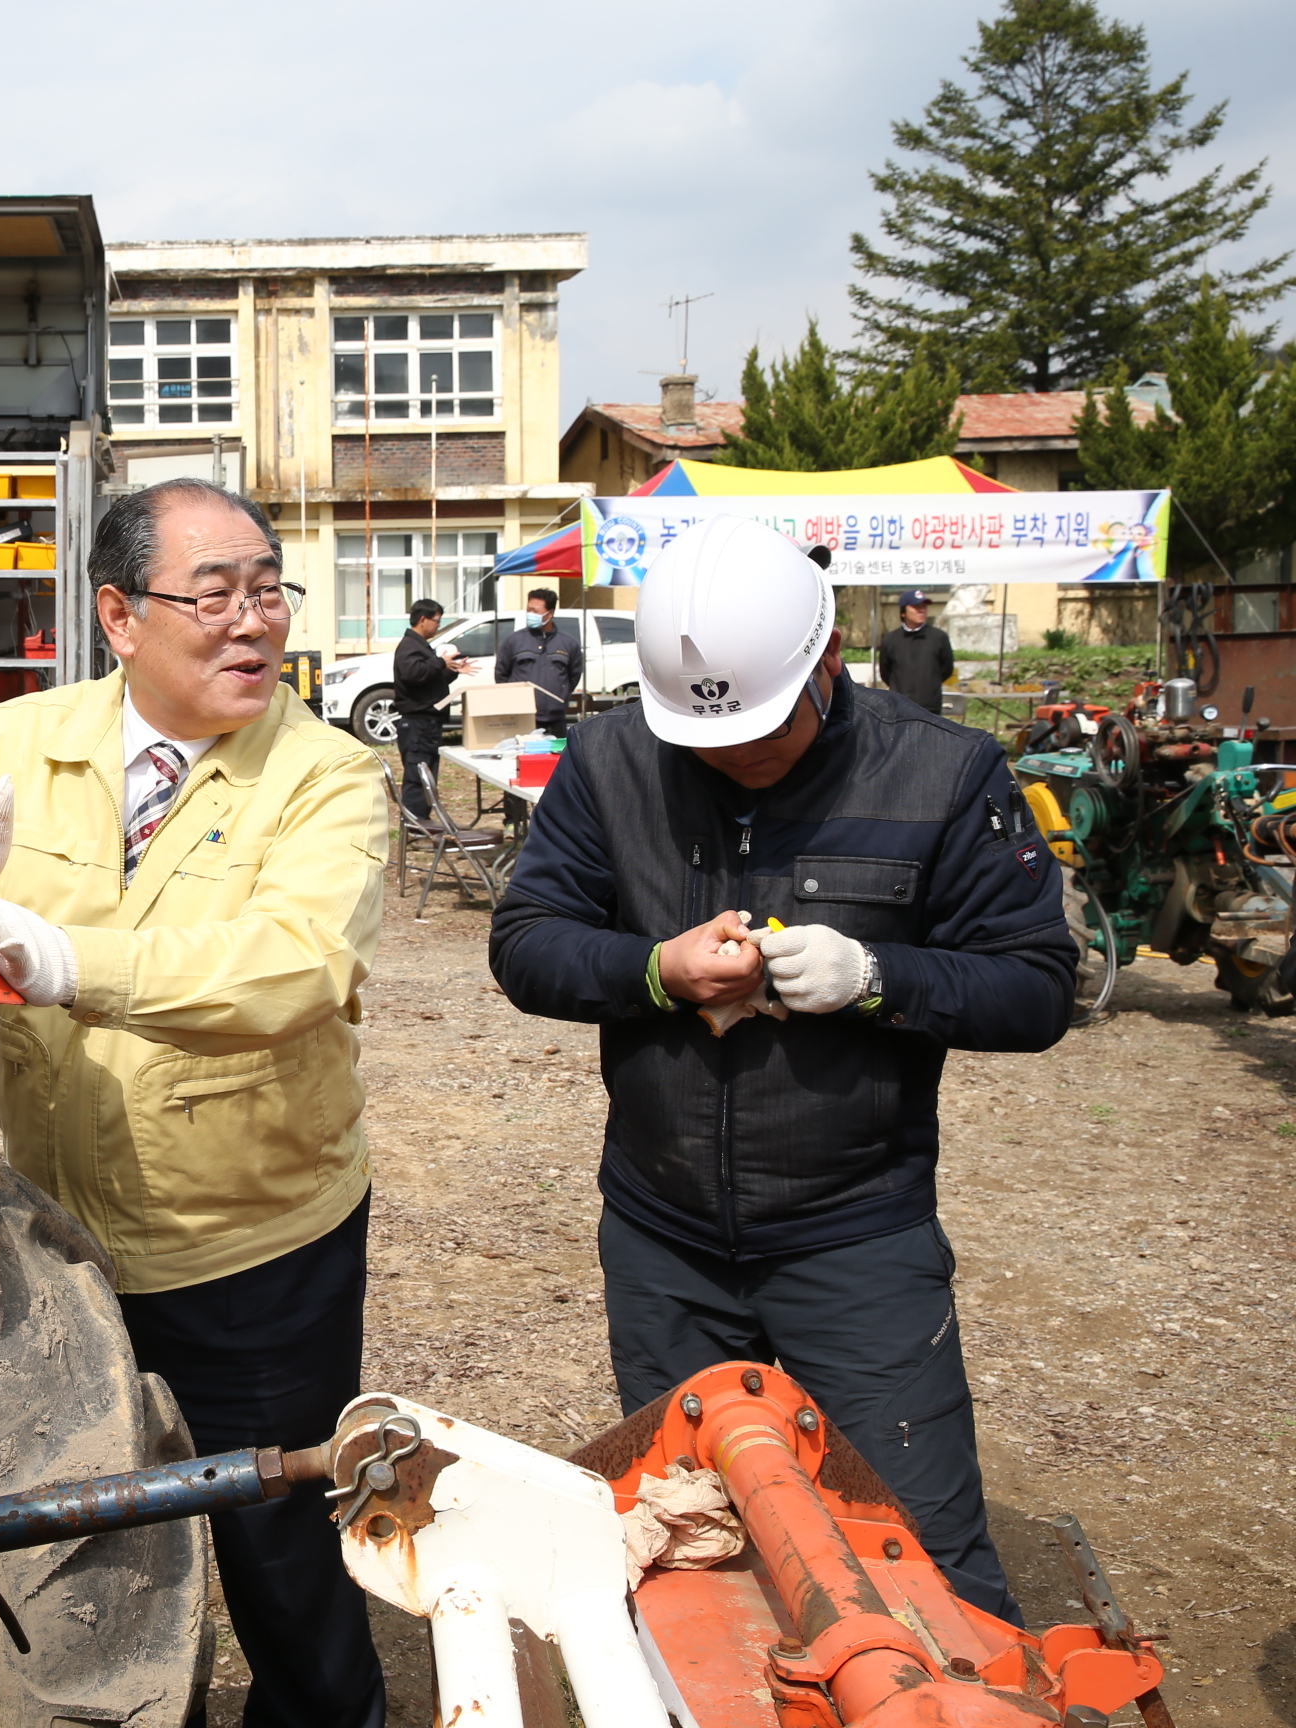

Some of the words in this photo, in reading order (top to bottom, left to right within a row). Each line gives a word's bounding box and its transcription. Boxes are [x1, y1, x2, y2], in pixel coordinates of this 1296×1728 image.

[805, 514, 860, 551] 예방을
[869, 514, 904, 550] 위한
[912, 513, 1004, 550] 야광반사판
[1012, 512, 1047, 548] 부착
[1055, 511, 1090, 547] 지원
[900, 559, 966, 575] 농업기계팀
[692, 700, 742, 716] 무주군
